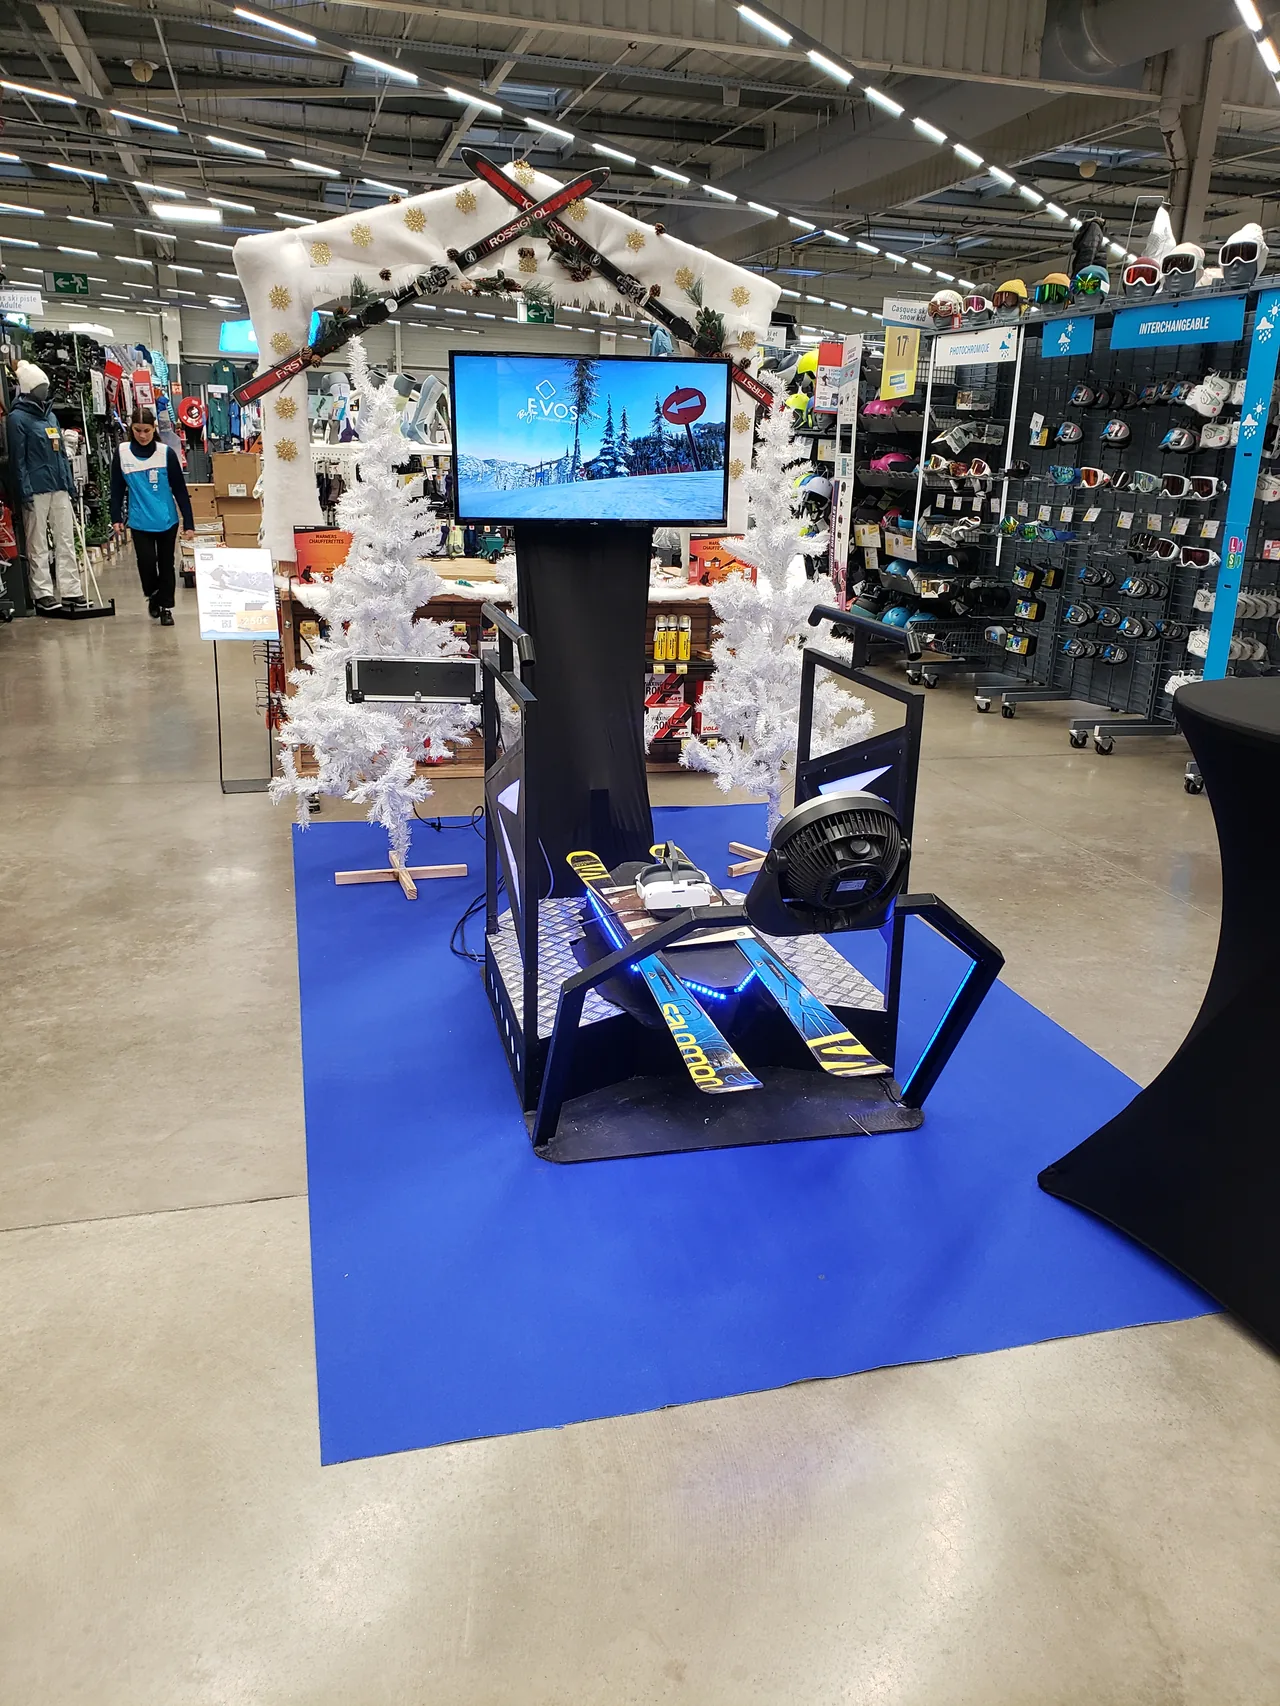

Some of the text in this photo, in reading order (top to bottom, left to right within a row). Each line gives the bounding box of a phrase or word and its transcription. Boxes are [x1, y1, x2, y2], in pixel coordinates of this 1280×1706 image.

[489, 207, 551, 248] ROSSIGNOL
[891, 304, 917, 315] Casques
[1139, 316, 1211, 335] INTERCHANGEABLE
[896, 334, 909, 357] 17
[949, 343, 990, 356] PHOTOCHROMIQUE
[275, 357, 304, 380] FIRST
[740, 377, 766, 399] FIRST
[516, 408, 534, 424] By
[527, 397, 578, 420] EVOS
[1230, 538, 1236, 549] L
[1228, 554, 1235, 565] S
[646, 686, 662, 695] RON
